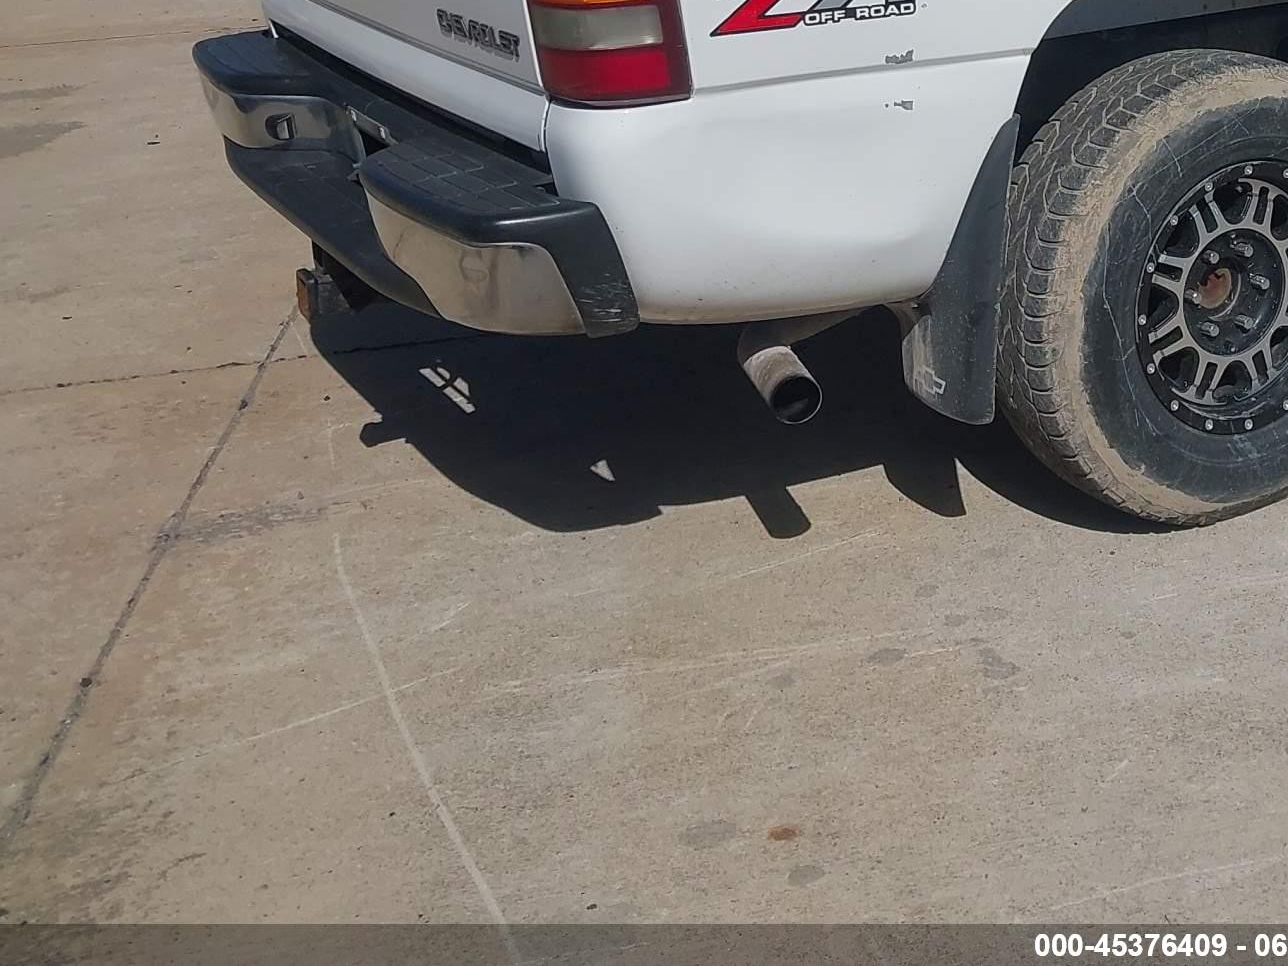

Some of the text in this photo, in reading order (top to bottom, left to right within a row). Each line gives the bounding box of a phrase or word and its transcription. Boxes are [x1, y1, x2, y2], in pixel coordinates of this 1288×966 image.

[804, 1, 915, 26] OFF ROAD
[436, 8, 520, 59] CHEVROLET
